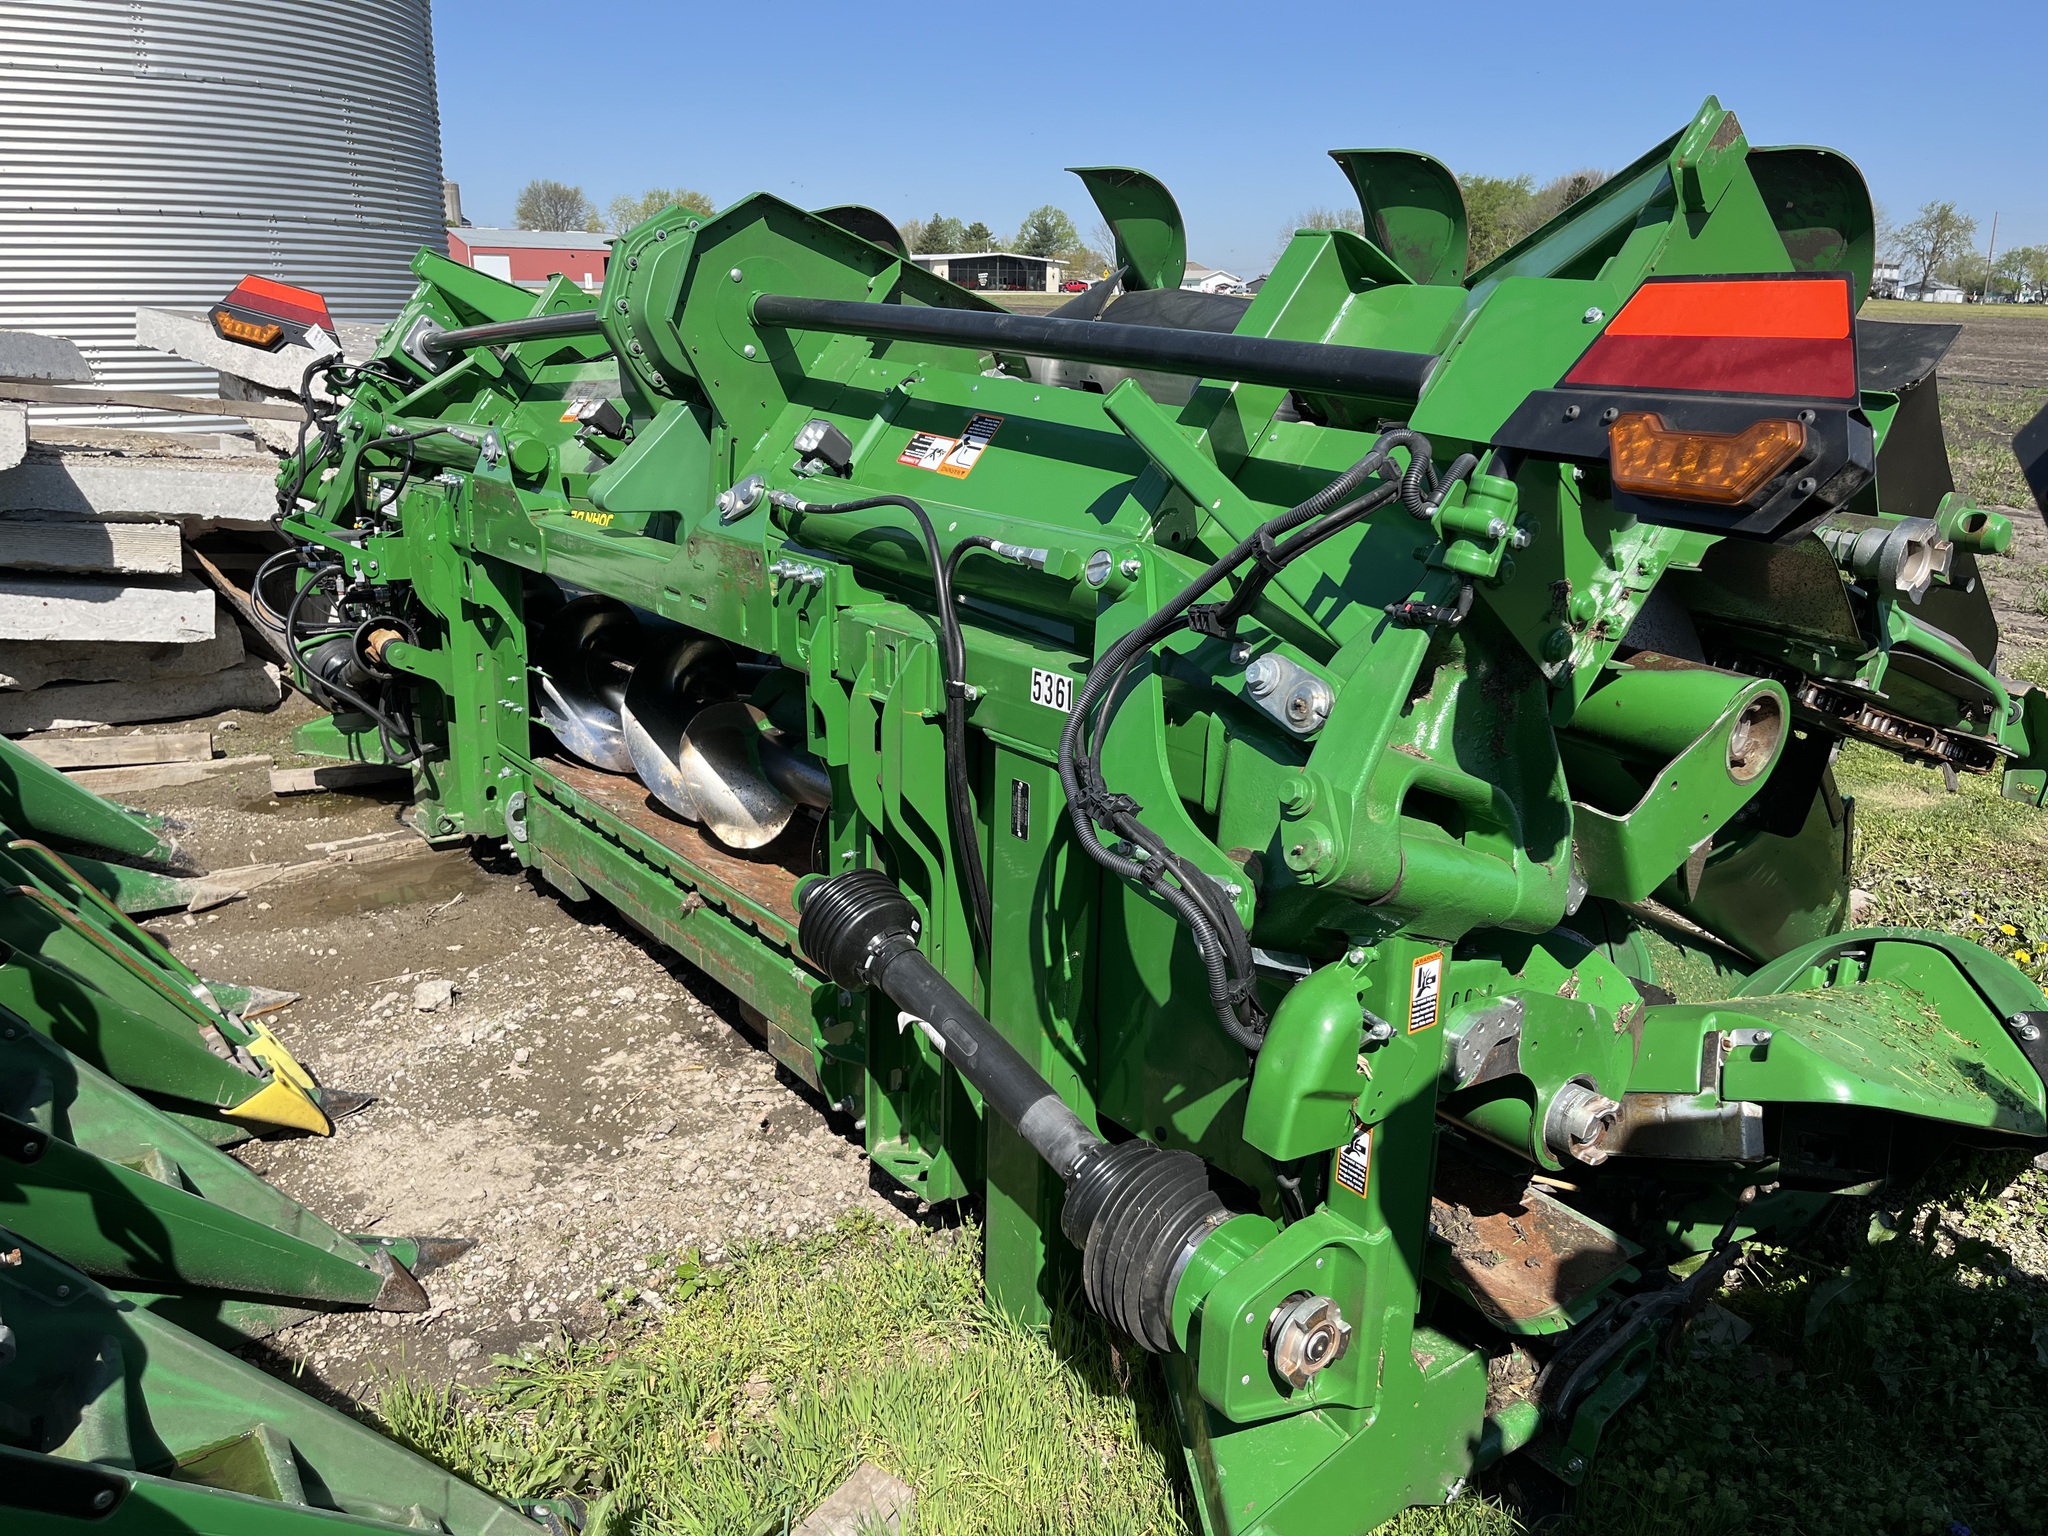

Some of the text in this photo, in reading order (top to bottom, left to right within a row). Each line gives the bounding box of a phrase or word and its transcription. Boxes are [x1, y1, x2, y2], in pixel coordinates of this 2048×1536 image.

[585, 512, 614, 527] JOHN
[1033, 670, 1072, 711] 5361
[1419, 952, 1442, 963] WARNING
